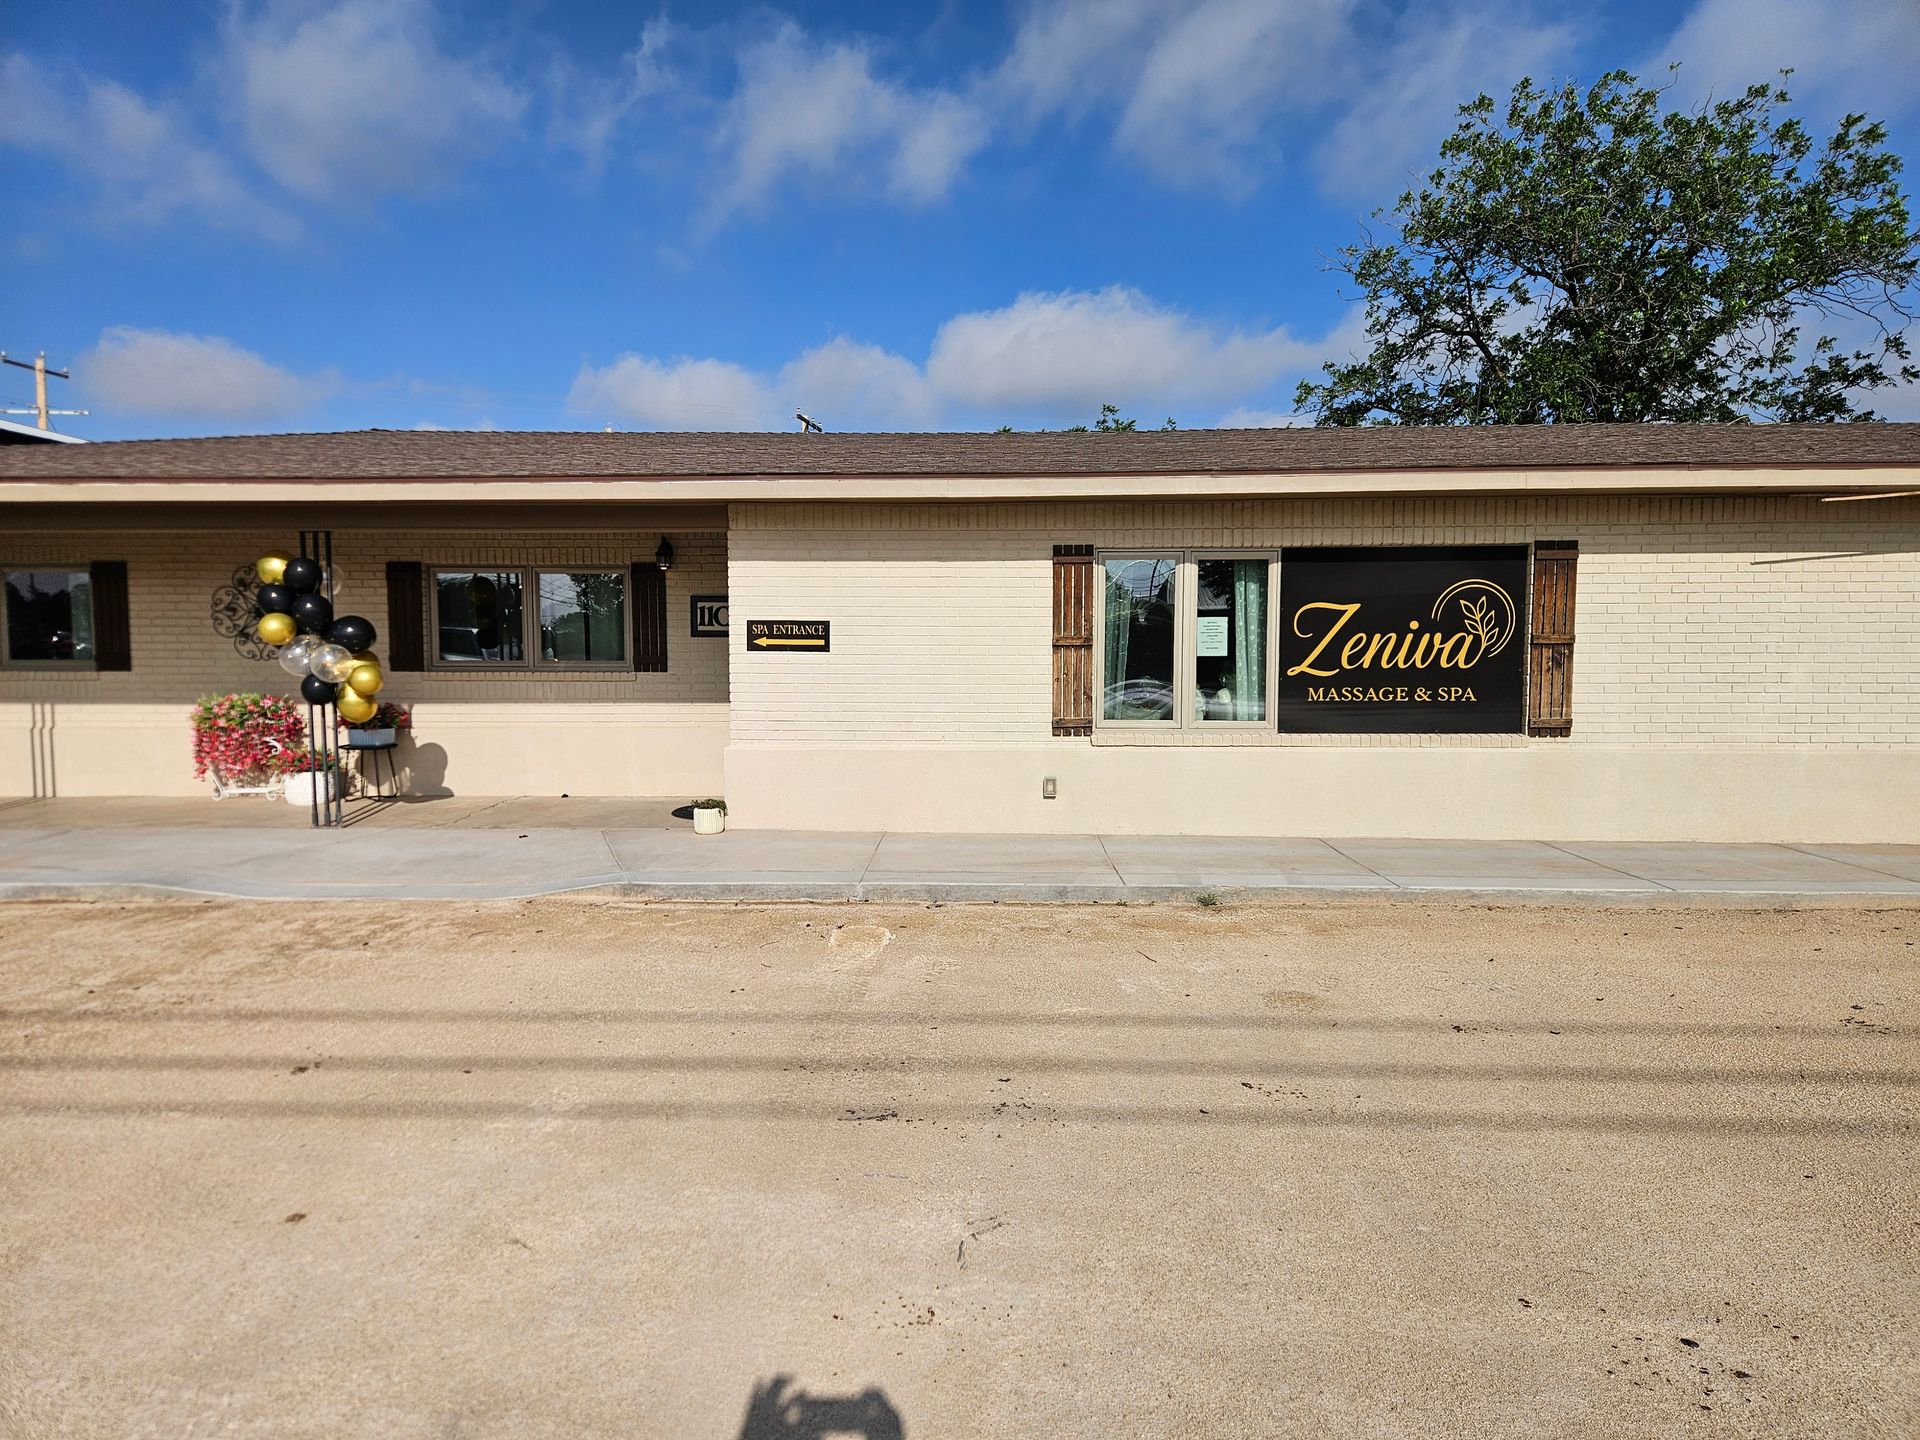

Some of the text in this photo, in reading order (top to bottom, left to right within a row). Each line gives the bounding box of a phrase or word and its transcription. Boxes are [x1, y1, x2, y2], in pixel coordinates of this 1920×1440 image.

[752, 624, 825, 635] SPA ENTRANCE
[1287, 601, 1484, 677] Zeniva
[1307, 687, 1477, 702] MASSAGE & SPA
